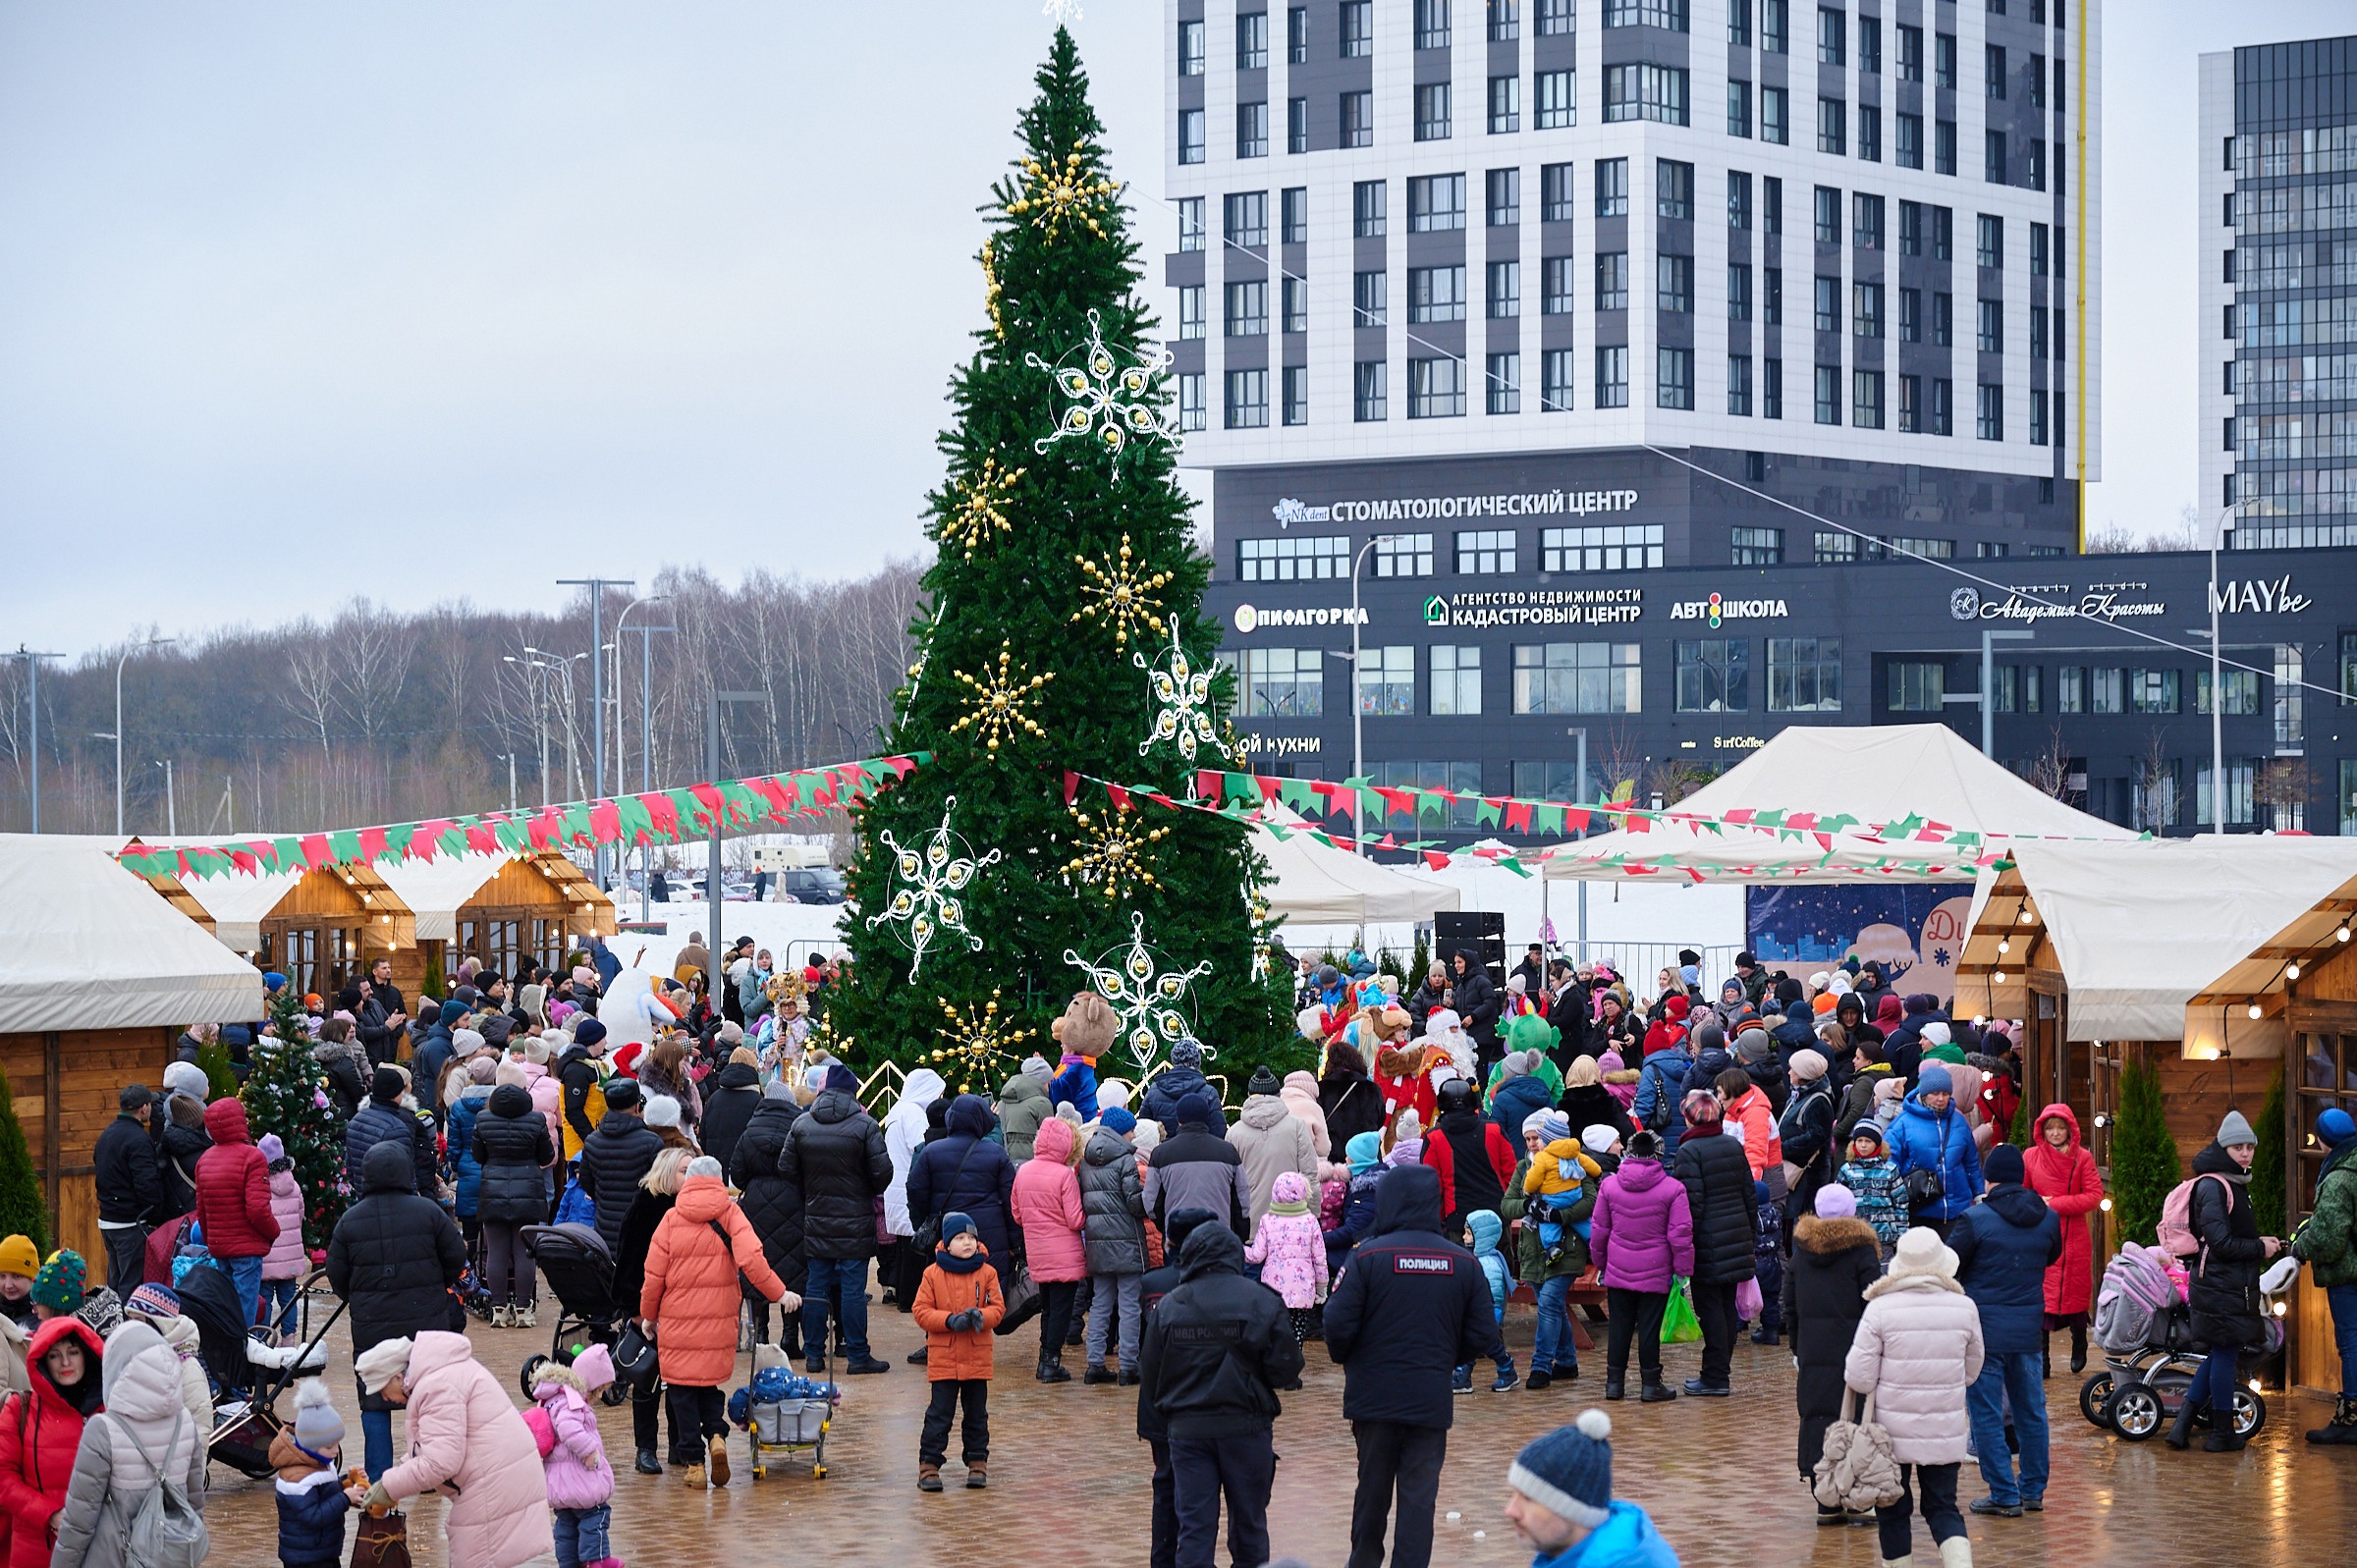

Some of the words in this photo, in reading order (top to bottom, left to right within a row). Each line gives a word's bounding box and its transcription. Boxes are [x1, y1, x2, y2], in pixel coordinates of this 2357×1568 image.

[1332, 489, 1563, 521] СТОМАТОЛОГИЧЕСКИЙ
[1568, 490, 1638, 516] ЦЕНТР
[1290, 508, 1309, 521] NK
[1453, 592, 1526, 606] АГЕНТСТВО
[1529, 589, 1641, 605] НЕДВИЖИМОСТИ
[1257, 608, 1369, 626] ПИФАГОРКА
[1453, 605, 1581, 628] КАДАСТРОВЫЙ
[1584, 606, 1641, 626] ЦЕНТР
[1980, 594, 2077, 623] Академия
[2081, 593, 2165, 622] Красоты
[1399, 1258, 1448, 1271] ПОЛИЦИЯ
